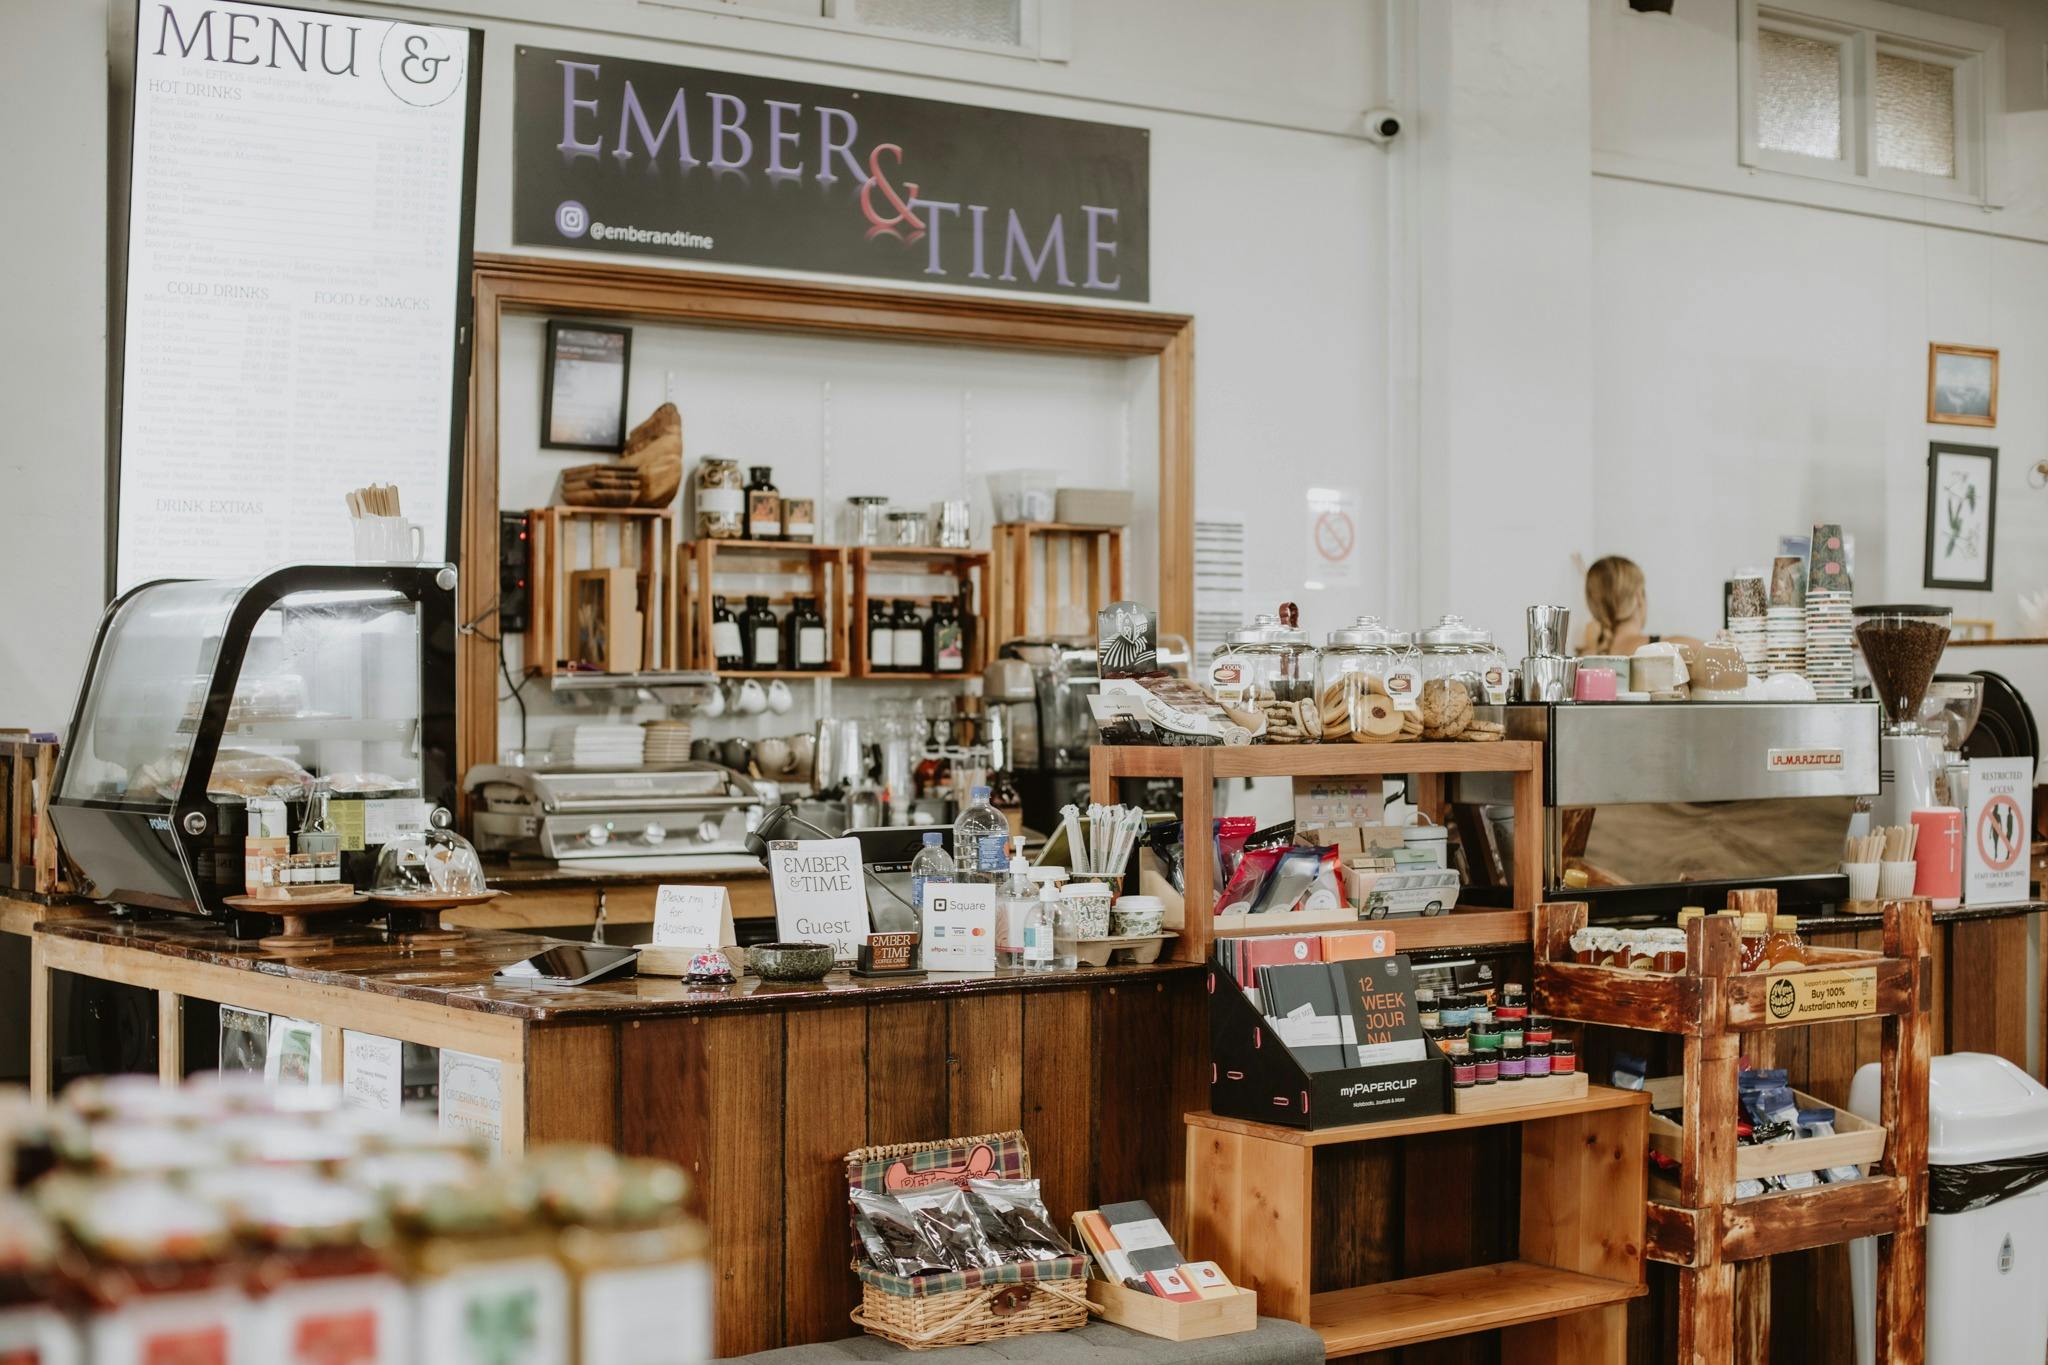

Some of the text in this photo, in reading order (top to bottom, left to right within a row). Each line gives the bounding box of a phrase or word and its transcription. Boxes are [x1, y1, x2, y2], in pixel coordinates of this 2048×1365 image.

[153, 4, 451, 84] MENU &
[149, 79, 180, 95] HOT
[185, 82, 242, 101] DRINKS
[556, 60, 877, 186] EMBER
[860, 143, 1121, 291] & TIME
[590, 222, 714, 250] @emberandtime
[167, 280, 208, 296] COLD
[214, 284, 270, 301] DRINKS
[314, 290, 432, 311] FOOD & SNACKS
[155, 499, 264, 514] DRINK EXTRAS
[1982, 771, 2023, 781] RESTRICTED
[1989, 786, 2014, 794] ACCESS
[784, 855, 850, 873] EMBER
[950, 901, 986, 912] Square
[796, 918, 852, 935] Guest
[873, 935, 911, 946] EMBER
[881, 947, 911, 958] TIME
[1359, 976, 1374, 992] 12
[1361, 992, 1406, 1011] WEEK
[1811, 987, 1845, 1000] Buy 100%
[1798, 999, 1859, 1012] Australian honey
[1366, 1011, 1406, 1030] JOUR
[1340, 1078, 1418, 1098] myPAPERCLIP
